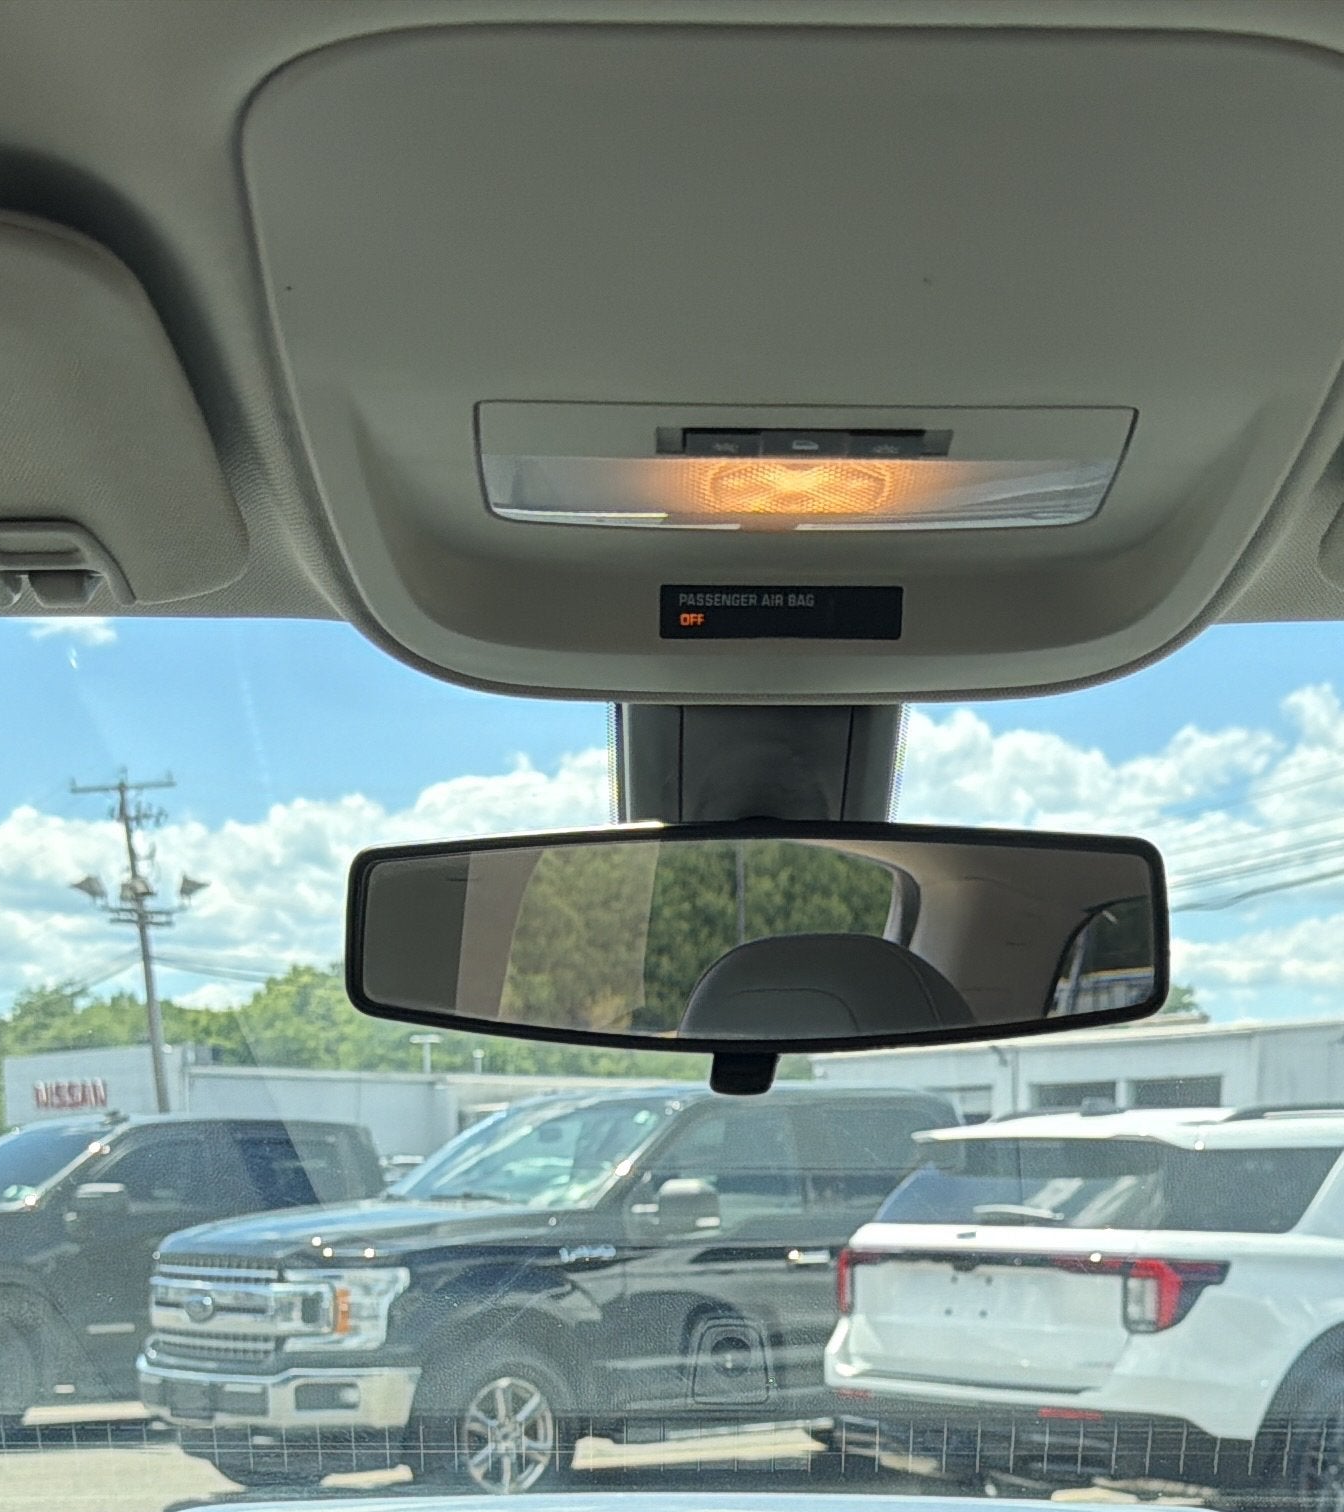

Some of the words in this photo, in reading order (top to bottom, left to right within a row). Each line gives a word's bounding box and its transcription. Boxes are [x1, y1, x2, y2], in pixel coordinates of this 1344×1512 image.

[679, 594, 756, 606] PASSENGER
[761, 594, 783, 606] AIR
[788, 594, 815, 607] BAG
[679, 613, 705, 626] OFF
[33, 1078, 108, 1110] NISSAN
